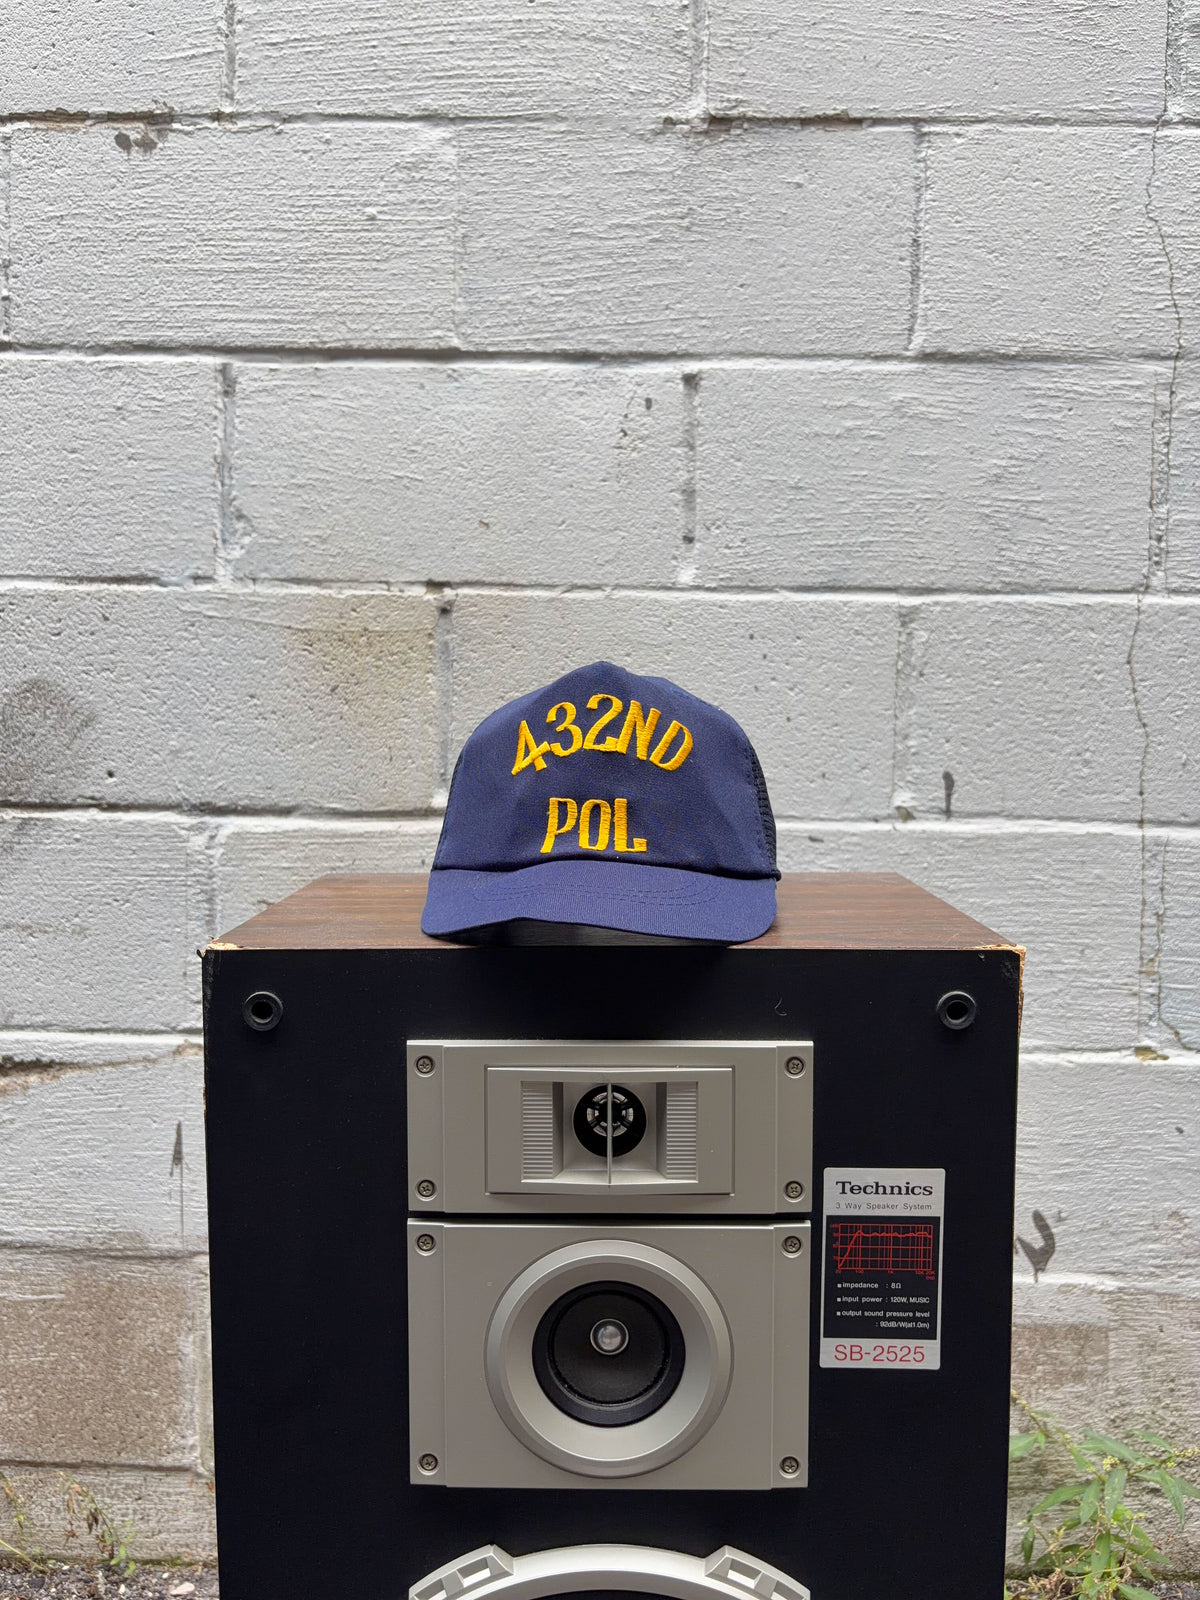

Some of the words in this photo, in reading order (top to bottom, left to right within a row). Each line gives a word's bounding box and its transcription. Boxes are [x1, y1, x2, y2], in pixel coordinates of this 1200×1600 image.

[511, 693, 694, 776] 432ND
[540, 797, 647, 854] POL
[835, 1180, 933, 1196] Technics
[835, 1202, 841, 1210] 3
[845, 1202, 862, 1211] Way
[866, 1202, 898, 1211] Speaker
[903, 1202, 932, 1211] System
[842, 1295, 859, 1303] input
[841, 1309, 862, 1317] output
[915, 1310, 930, 1318] level
[834, 1344, 925, 1363] SB-2525
